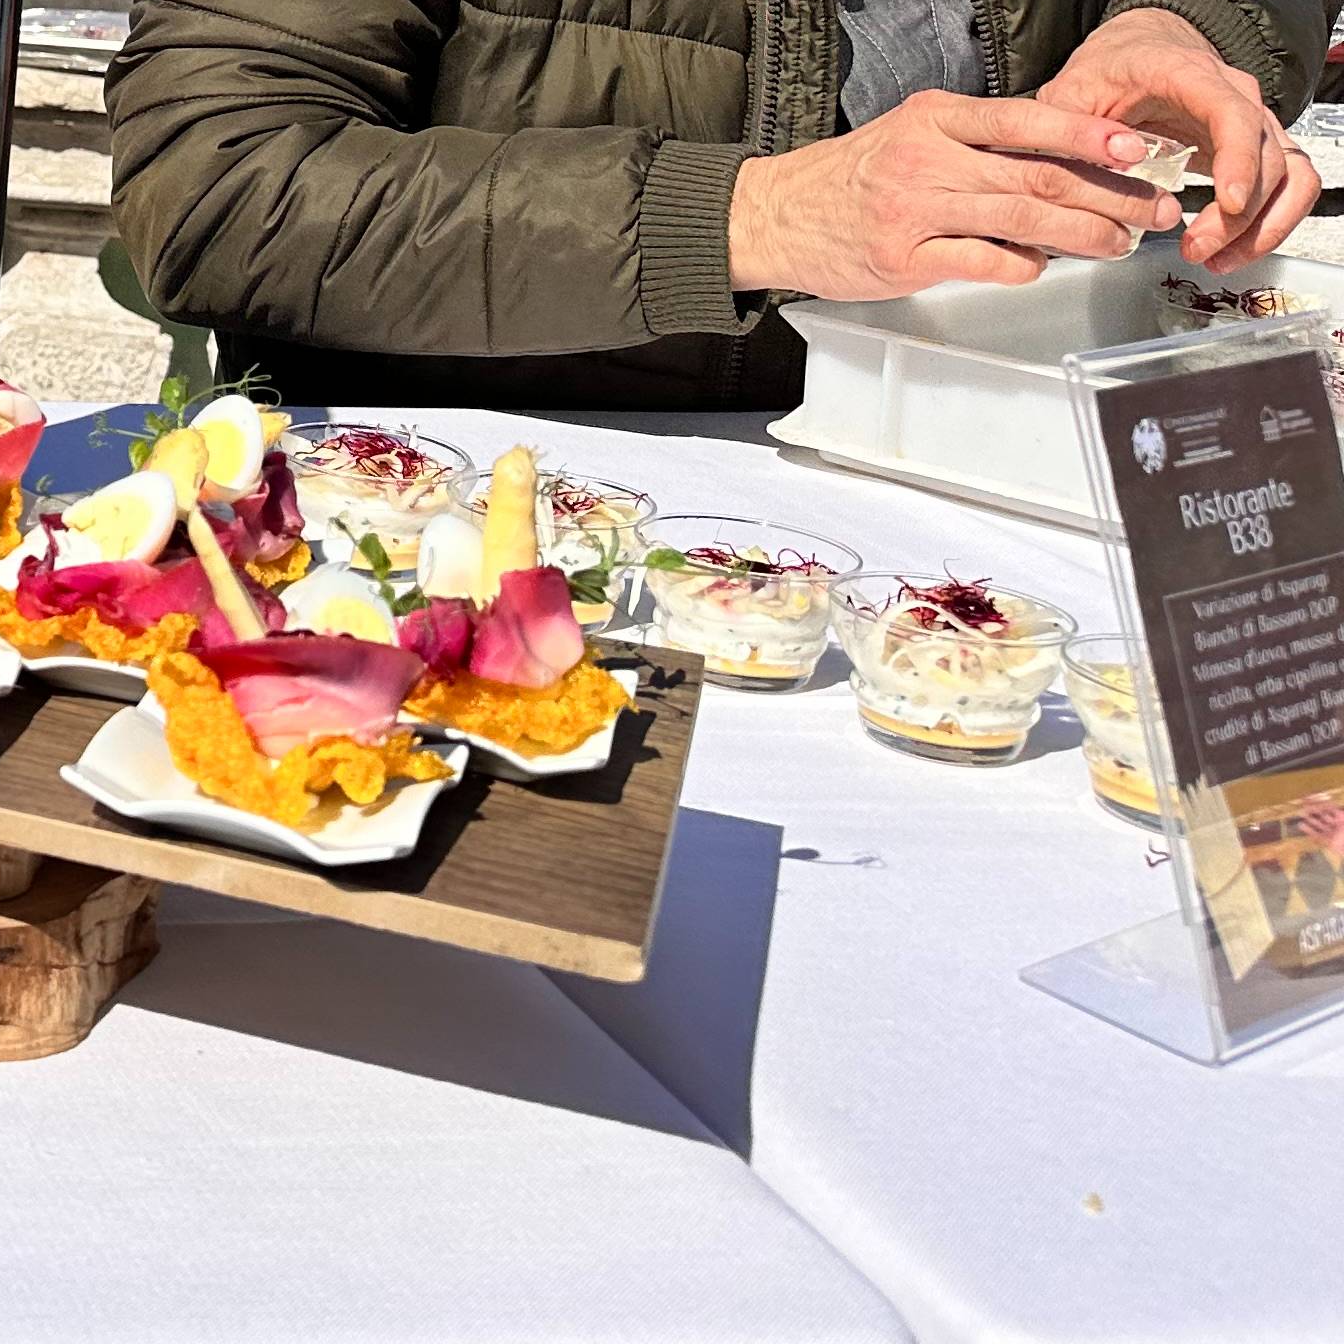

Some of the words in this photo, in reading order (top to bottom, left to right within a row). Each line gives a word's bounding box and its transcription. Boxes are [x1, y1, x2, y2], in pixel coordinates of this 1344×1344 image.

[1179, 478, 1296, 529] Ristorante
[1226, 514, 1274, 554] B38
[1192, 590, 1258, 620] Variazione
[1261, 582, 1275, 602] di
[1277, 572, 1329, 599] Asparagi
[1193, 624, 1240, 651] Bianchi
[1242, 618, 1255, 637] di
[1257, 607, 1308, 632] Bassano
[1308, 596, 1339, 619] DOP
[1289, 631, 1335, 655] mousse
[1255, 676, 1285, 696] erba
[1251, 708, 1264, 730] di
[1267, 698, 1319, 726] Asparagi
[1245, 744, 1258, 766] di
[1259, 731, 1310, 760] Bassano
[1311, 717, 1343, 743] DOP
